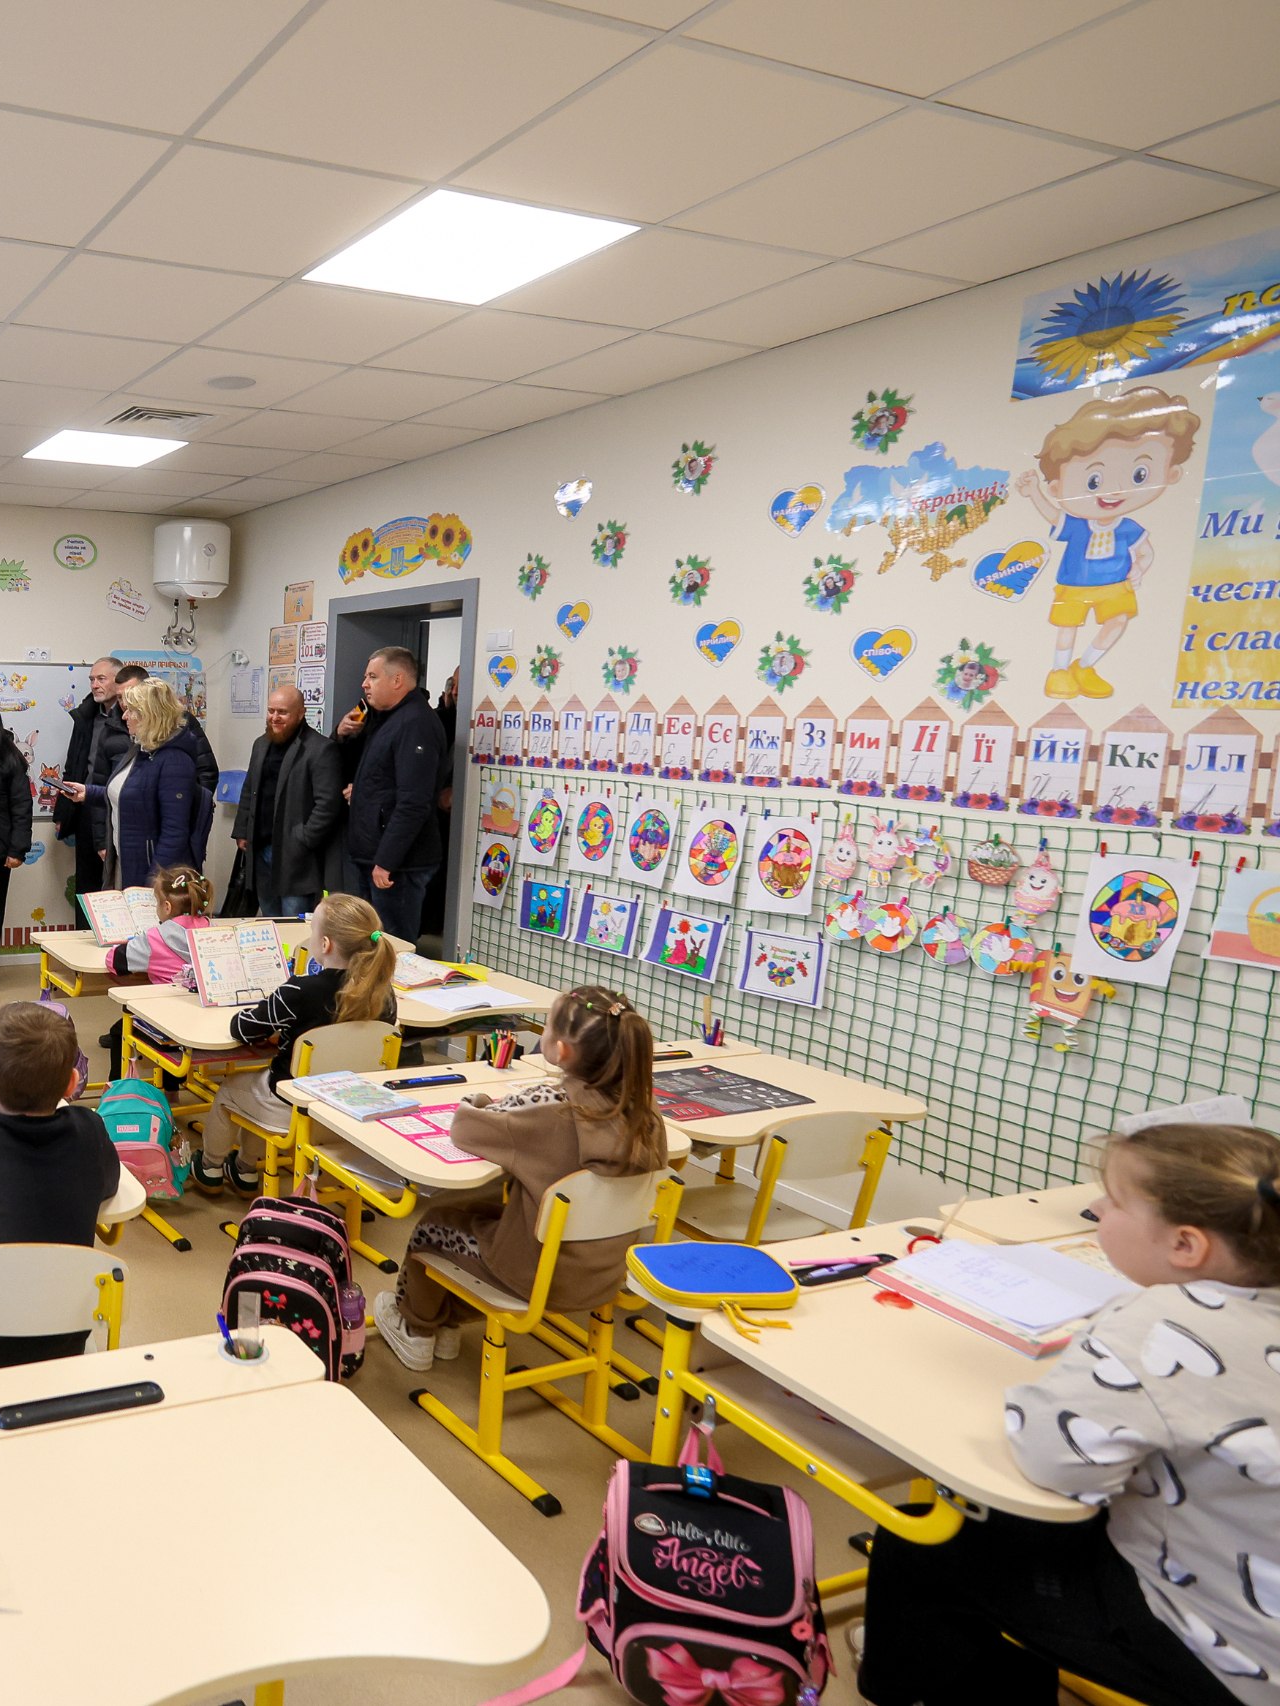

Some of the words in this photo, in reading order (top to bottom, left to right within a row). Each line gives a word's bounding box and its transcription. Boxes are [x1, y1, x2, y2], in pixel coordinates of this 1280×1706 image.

[1200, 509, 1264, 539] Ми
[1184, 624, 1198, 652] і
[301, 645, 314, 658] 101
[303, 689, 313, 702] 03
[476, 713, 495, 728] Аа
[504, 713, 521, 729] Бб
[531, 713, 552, 732] Вв
[565, 712, 582, 730] Гг
[594, 713, 616, 733] Ґґ
[629, 713, 652, 736] Дд
[664, 717, 692, 735] Ее
[708, 722, 733, 743] Єє
[748, 729, 780, 750] Жж
[801, 722, 826, 748] Зз
[849, 731, 881, 750] Ии
[911, 725, 941, 752] Іі
[972, 732, 996, 763] Її
[1030, 733, 1081, 764] Йй
[1104, 743, 1160, 769] Кк
[1185, 745, 1247, 773] Лл
[652, 1537, 764, 1597] Angel
